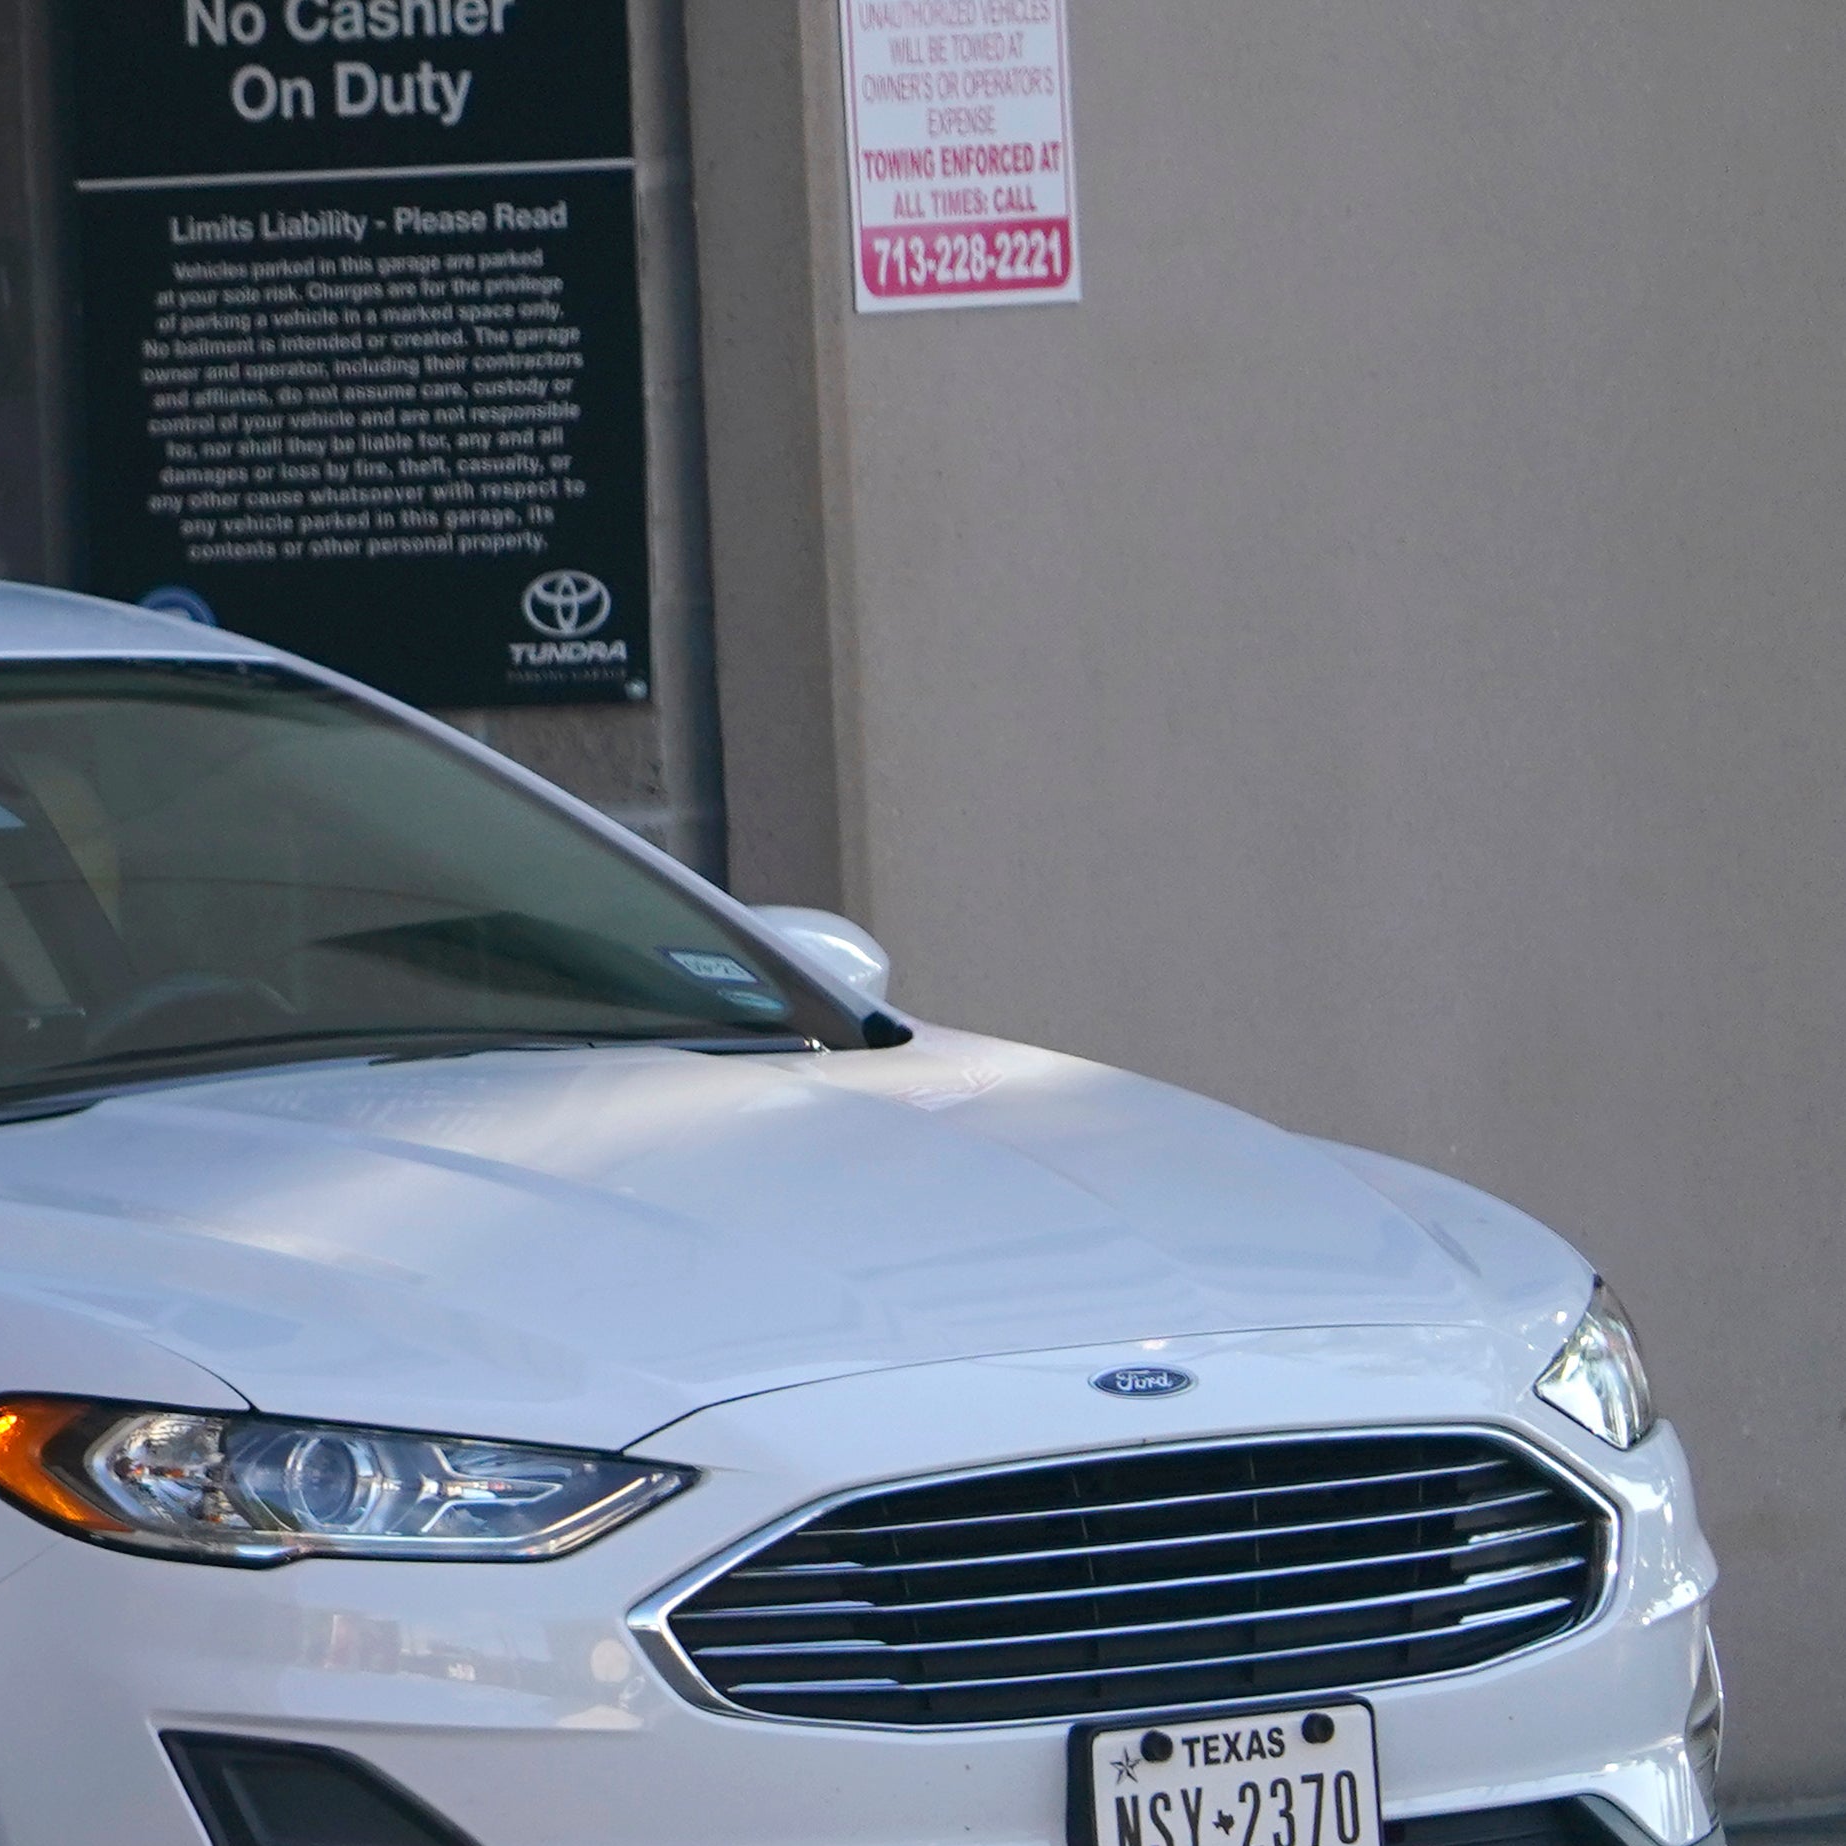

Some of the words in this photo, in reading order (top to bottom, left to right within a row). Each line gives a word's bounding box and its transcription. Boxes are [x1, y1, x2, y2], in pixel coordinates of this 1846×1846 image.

[185, 0, 267, 46] No
[889, 35, 925, 65] WILL
[927, 33, 949, 63] BE
[951, 31, 1005, 62] TOWED
[1007, 30, 1025, 59] AT
[231, 63, 315, 122] On
[334, 60, 473, 127] Duty
[936, 70, 960, 100] OR
[927, 104, 998, 138] EXPENSE
[863, 147, 935, 182] TOWING
[941, 143, 1035, 178] ENFORCED
[1040, 140, 1061, 172] AT
[893, 189, 926, 219] ALL
[993, 183, 1038, 213] CALL
[169, 214, 254, 245] Limits
[260, 209, 367, 243] Liability
[393, 206, 488, 235] Please
[494, 199, 568, 231] Read
[173, 259, 248, 279] Vehicles
[251, 257, 315, 281] parked
[318, 257, 336, 274] in
[338, 255, 373, 273] this
[376, 256, 441, 277] garage
[444, 255, 475, 269] are
[477, 249, 543, 273] parked
[872, 226, 1064, 288] 713-228-2221
[156, 288, 175, 304] at
[178, 289, 219, 308] your
[305, 279, 384, 304] Charges
[386, 281, 417, 296] are
[419, 276, 446, 294] for
[450, 275, 481, 293] the
[156, 313, 176, 330] of
[179, 310, 252, 334] parking
[254, 313, 268, 327] a
[270, 307, 338, 326] vehicle
[342, 307, 360, 324] in
[363, 309, 377, 323] a
[379, 303, 453, 322] marked
[457, 305, 514, 325] space
[142, 338, 170, 356] No
[257, 335, 275, 352] is
[277, 332, 362, 351] intended
[365, 335, 386, 348] or
[474, 327, 509, 345] The
[512, 328, 580, 349] garage
[141, 367, 200, 382] owner
[203, 361, 240, 380] and
[332, 355, 420, 380] including
[423, 353, 468, 371] their
[471, 349, 583, 370] contractors
[153, 389, 189, 407] and
[276, 385, 302, 403] do
[305, 385, 338, 402] not
[342, 385, 416, 401] assume
[471, 376, 549, 401] custody
[551, 379, 573, 393] or
[147, 414, 215, 433] control
[218, 413, 238, 431] of
[241, 415, 284, 435] your
[287, 409, 356, 428] vehicle
[359, 407, 394, 426] and
[398, 410, 430, 424] are
[432, 406, 466, 423] not
[468, 401, 581, 427] responsible
[199, 443, 232, 457] nor
[236, 437, 283, 456] shall
[285, 435, 327, 459] they
[330, 434, 356, 452] be
[361, 432, 413, 451] liable
[455, 433, 492, 452] any
[495, 427, 534, 446] and
[537, 426, 564, 444] all
[159, 463, 248, 489] damages
[252, 466, 273, 480] or
[280, 460, 321, 479] loss
[323, 459, 348, 482] by
[549, 455, 573, 469] or
[148, 495, 182, 514] any
[186, 489, 240, 508] other
[245, 491, 304, 506] cause
[309, 483, 425, 504] whatsoever
[430, 482, 475, 500] with
[479, 480, 558, 504] respect
[563, 479, 586, 496] to
[180, 520, 216, 539] any
[221, 513, 294, 532] vehicle
[298, 511, 370, 535] parked
[375, 511, 395, 527] in
[399, 508, 439, 527] this
[187, 540, 277, 559] contents
[280, 542, 304, 556] or
[308, 536, 360, 555] other
[365, 533, 453, 558] personal
[509, 640, 627, 666] TUNDRA
[1116, 1370, 1174, 1391] Ford
[1182, 1726, 1285, 1768] TEXAS
